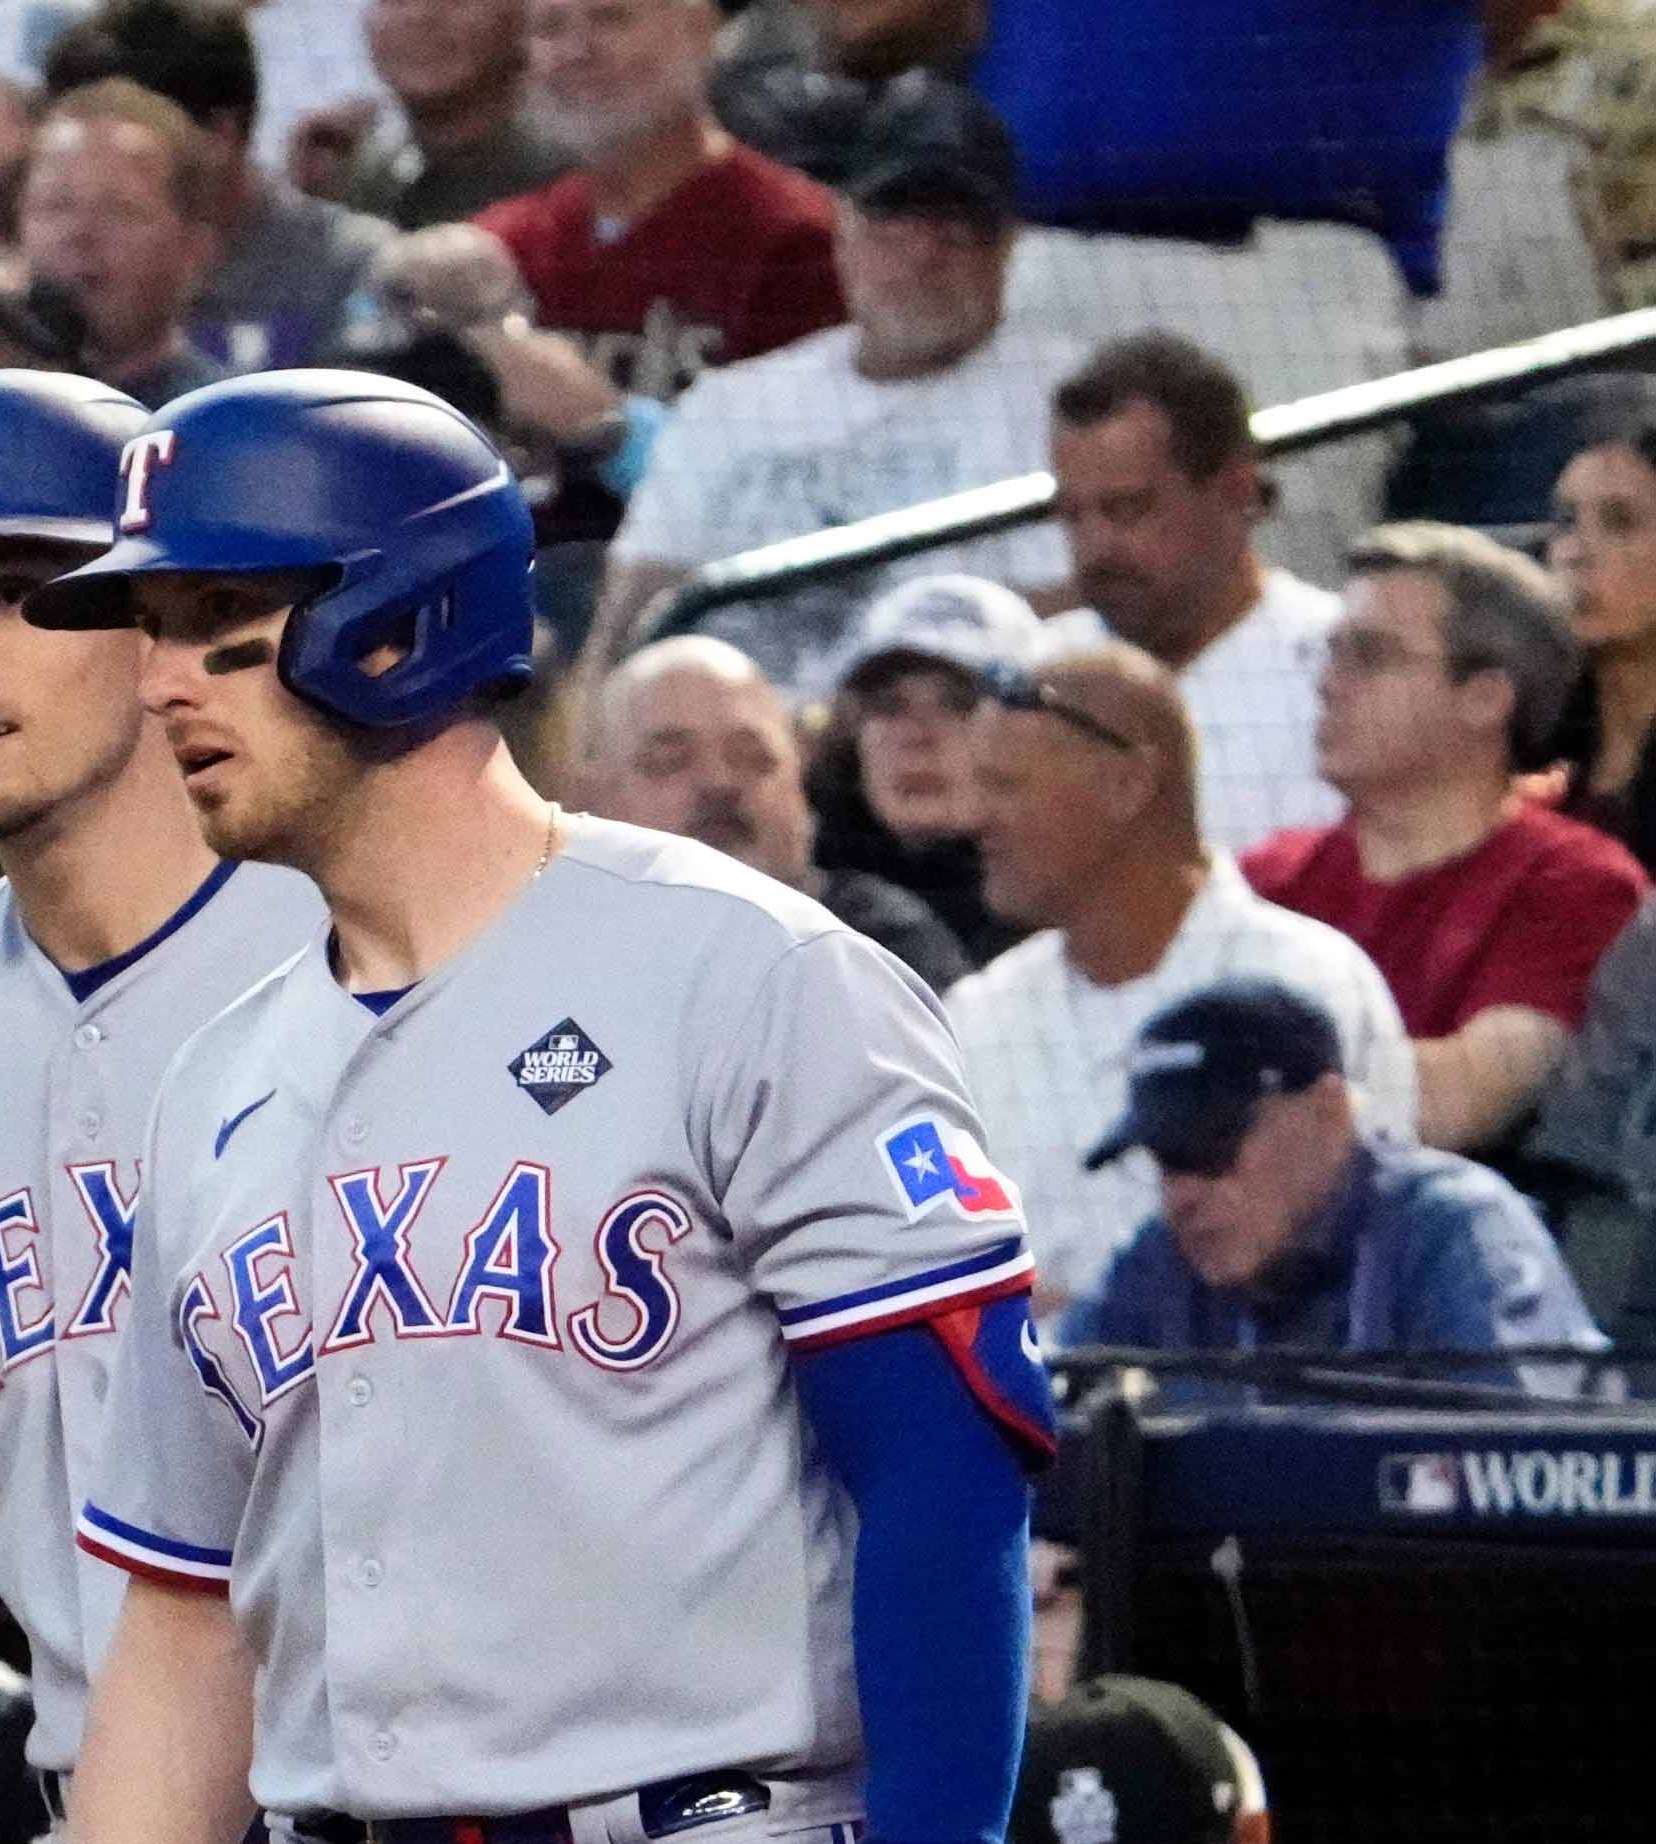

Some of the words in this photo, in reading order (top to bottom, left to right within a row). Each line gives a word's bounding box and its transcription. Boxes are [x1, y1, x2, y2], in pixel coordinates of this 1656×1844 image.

[119, 430, 176, 532] T
[519, 1066, 596, 1085] SERIES
[523, 1050, 599, 1067] WORLD
[175, 1155, 693, 1453] TEXAS
